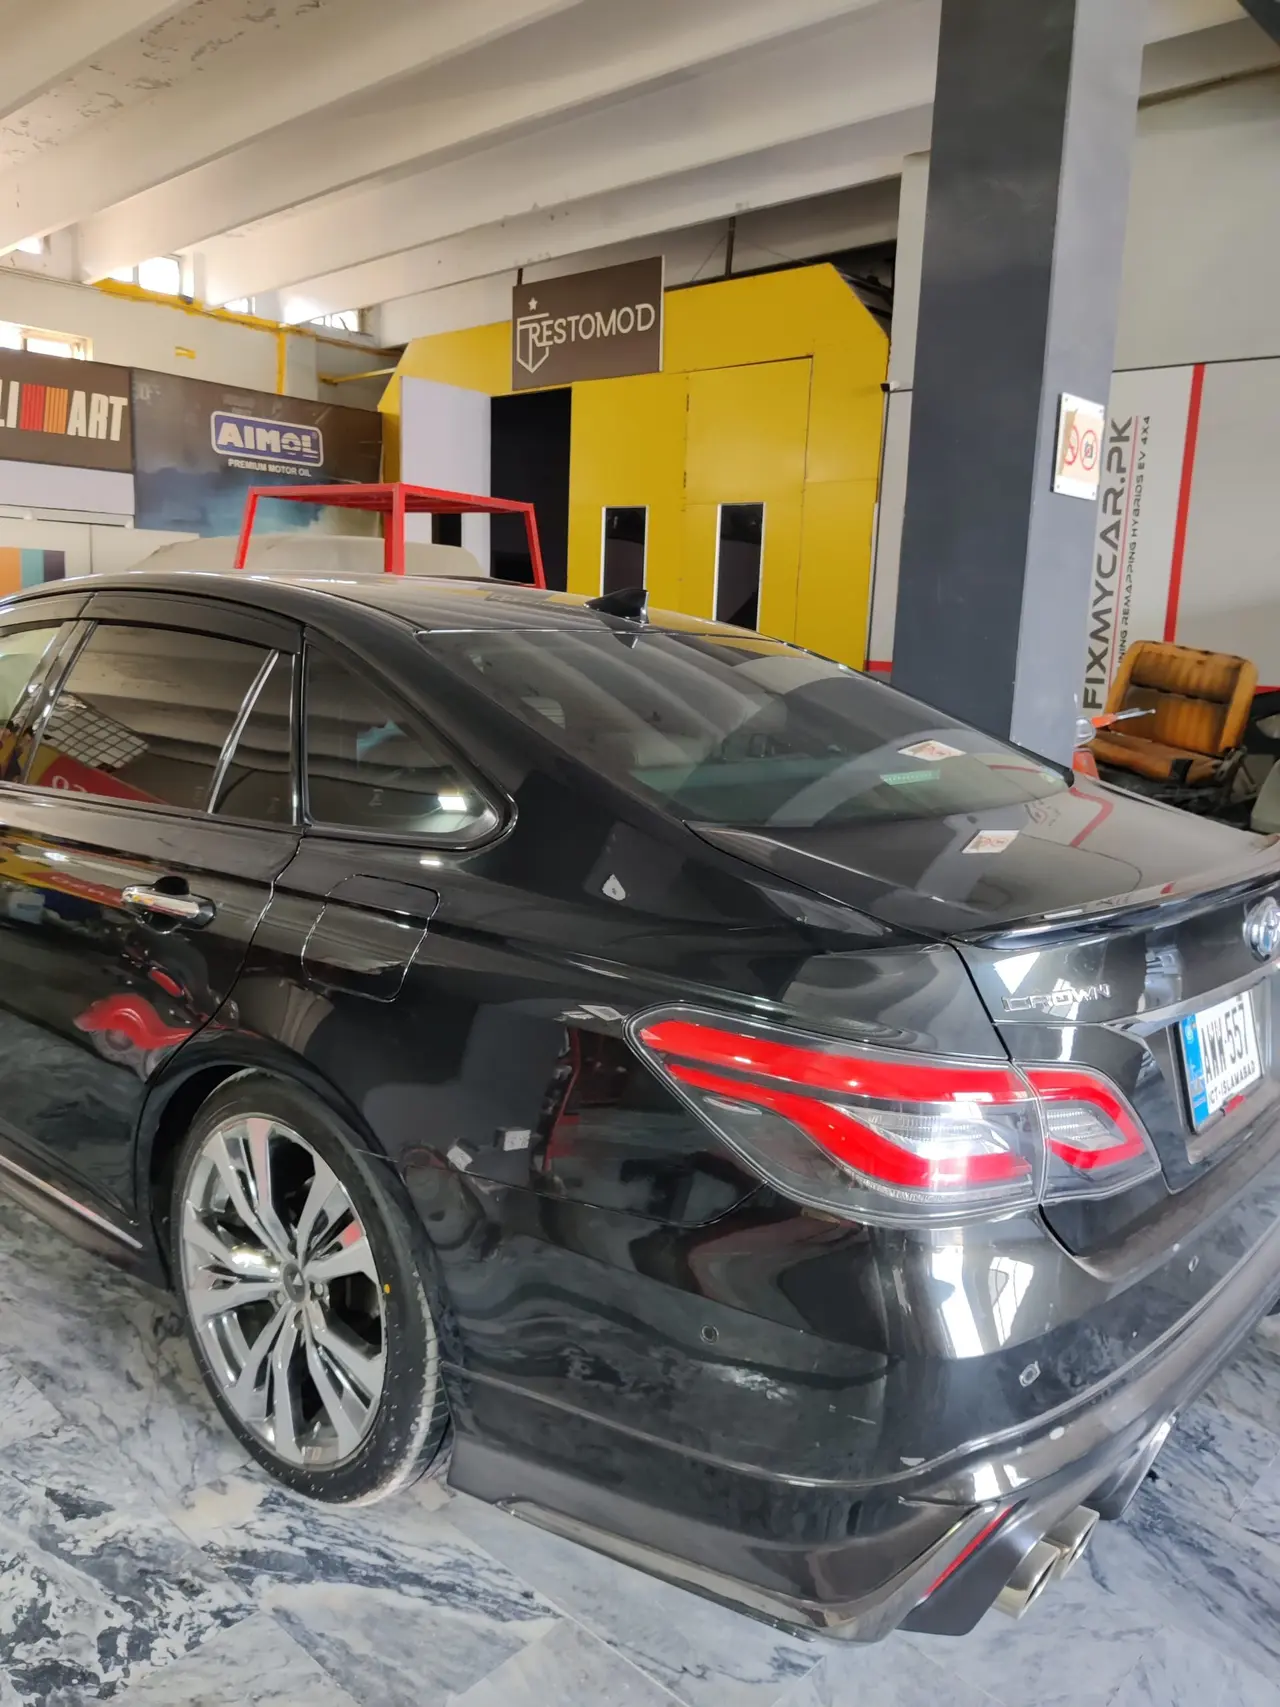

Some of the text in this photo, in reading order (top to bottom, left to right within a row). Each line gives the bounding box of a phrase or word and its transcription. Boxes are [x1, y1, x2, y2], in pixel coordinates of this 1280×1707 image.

[528, 303, 655, 348] RESTOMOD
[0, 378, 128, 441] I ART
[217, 422, 319, 458] AIMOL
[1137, 451, 1146, 470] EV
[228, 458, 312, 477] PREMIUM MOTOR OIL
[1131, 474, 1144, 537] HYBRIDS
[1083, 415, 1132, 709] FIXMYCAR.PK
[1121, 542, 1137, 625] REMAPPING
